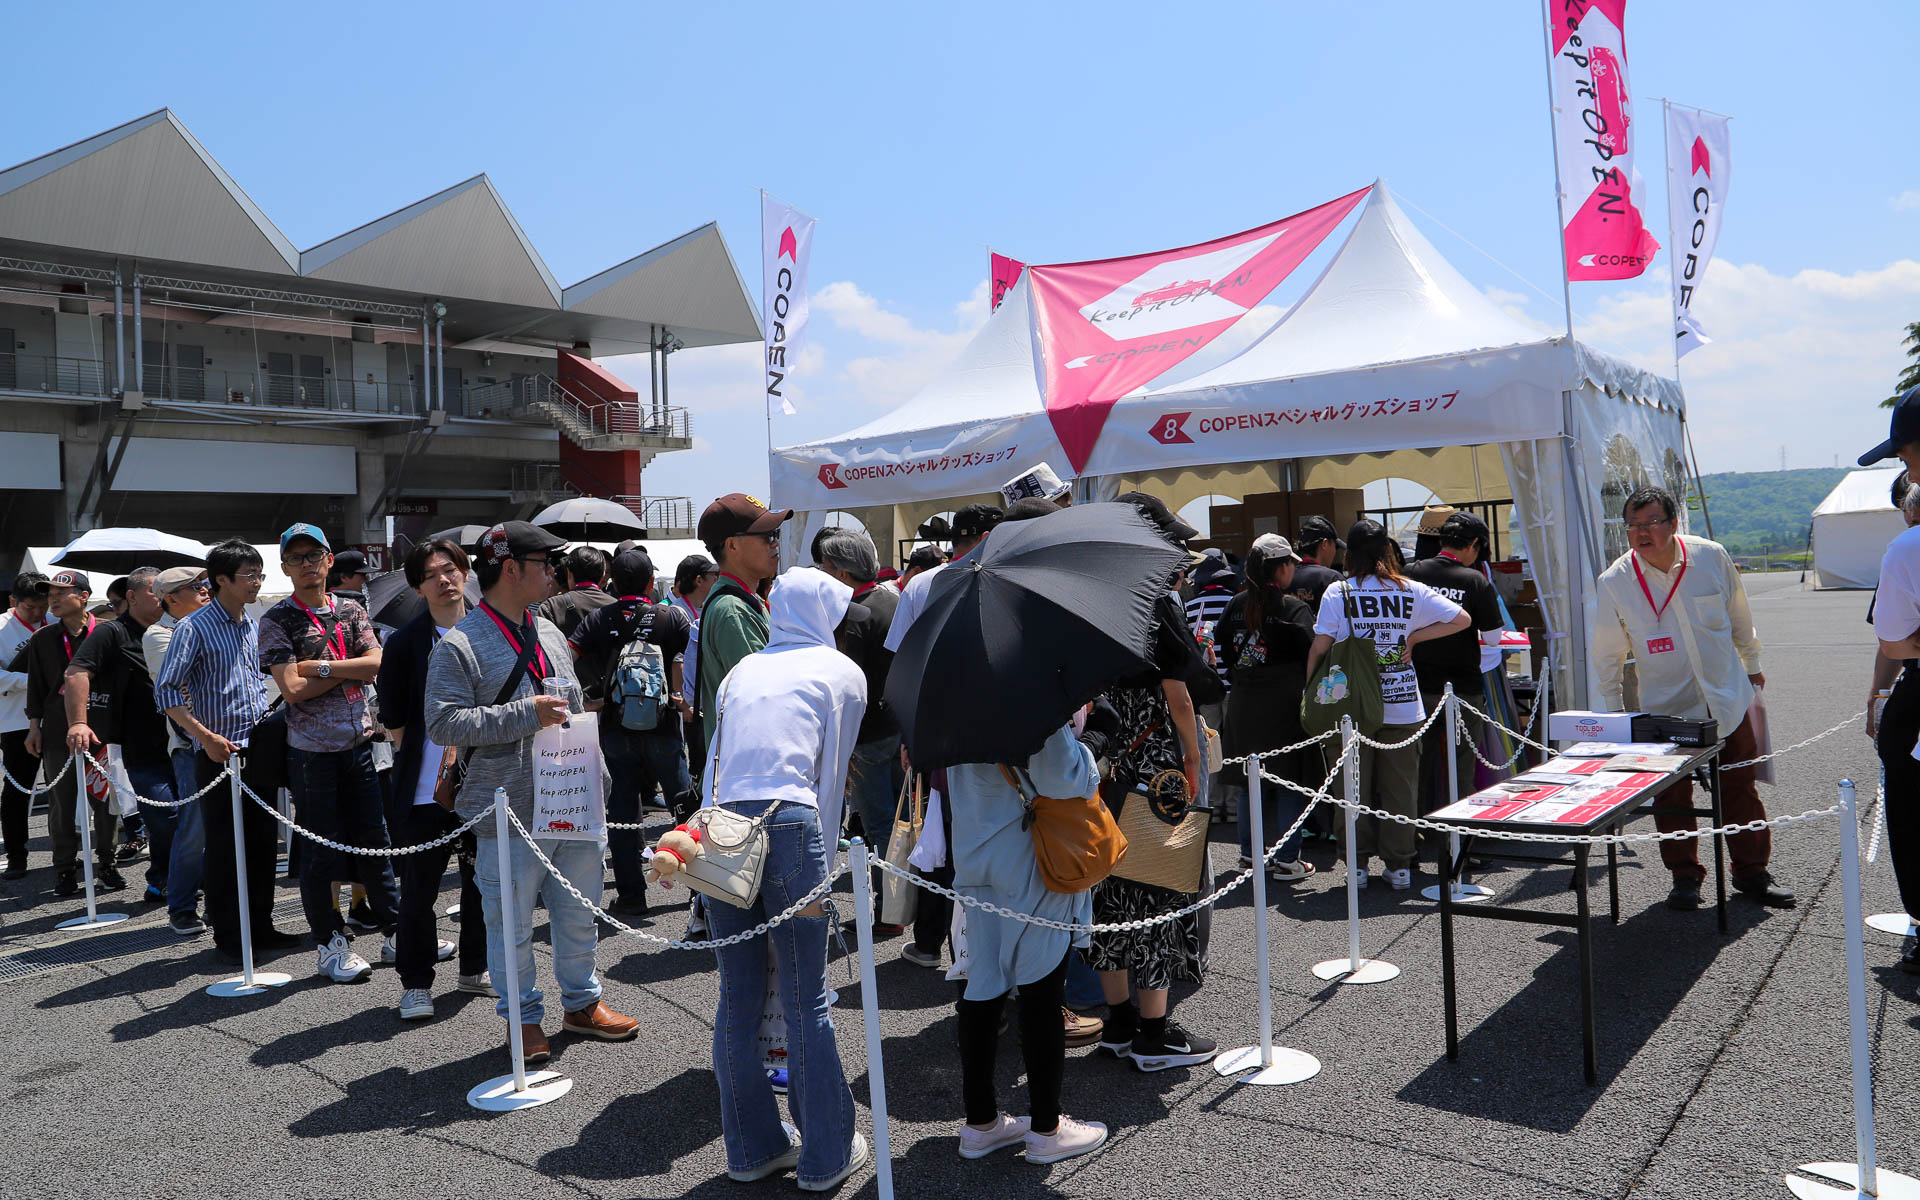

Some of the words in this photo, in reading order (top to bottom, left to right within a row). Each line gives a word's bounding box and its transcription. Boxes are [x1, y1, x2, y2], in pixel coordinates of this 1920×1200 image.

[1576, 80, 1597, 100] it
[1089, 306, 1143, 325] Keep
[1149, 299, 1161, 312] it
[1170, 271, 1254, 307] OPEN.
[767, 267, 792, 397] COPEN
[1096, 336, 1204, 364] COPEN
[1199, 389, 1461, 434] COPENスペシャルグッズショップ
[1163, 418, 1178, 439] 8
[844, 444, 1018, 481] COPENスペシャルグッズショップ
[826, 468, 835, 484] 8
[368, 553, 382, 570] N
[541, 749, 559, 759] Keep
[540, 768, 557, 779] Keep
[540, 787, 556, 798] Keep
[540, 806, 556, 817] Keep
